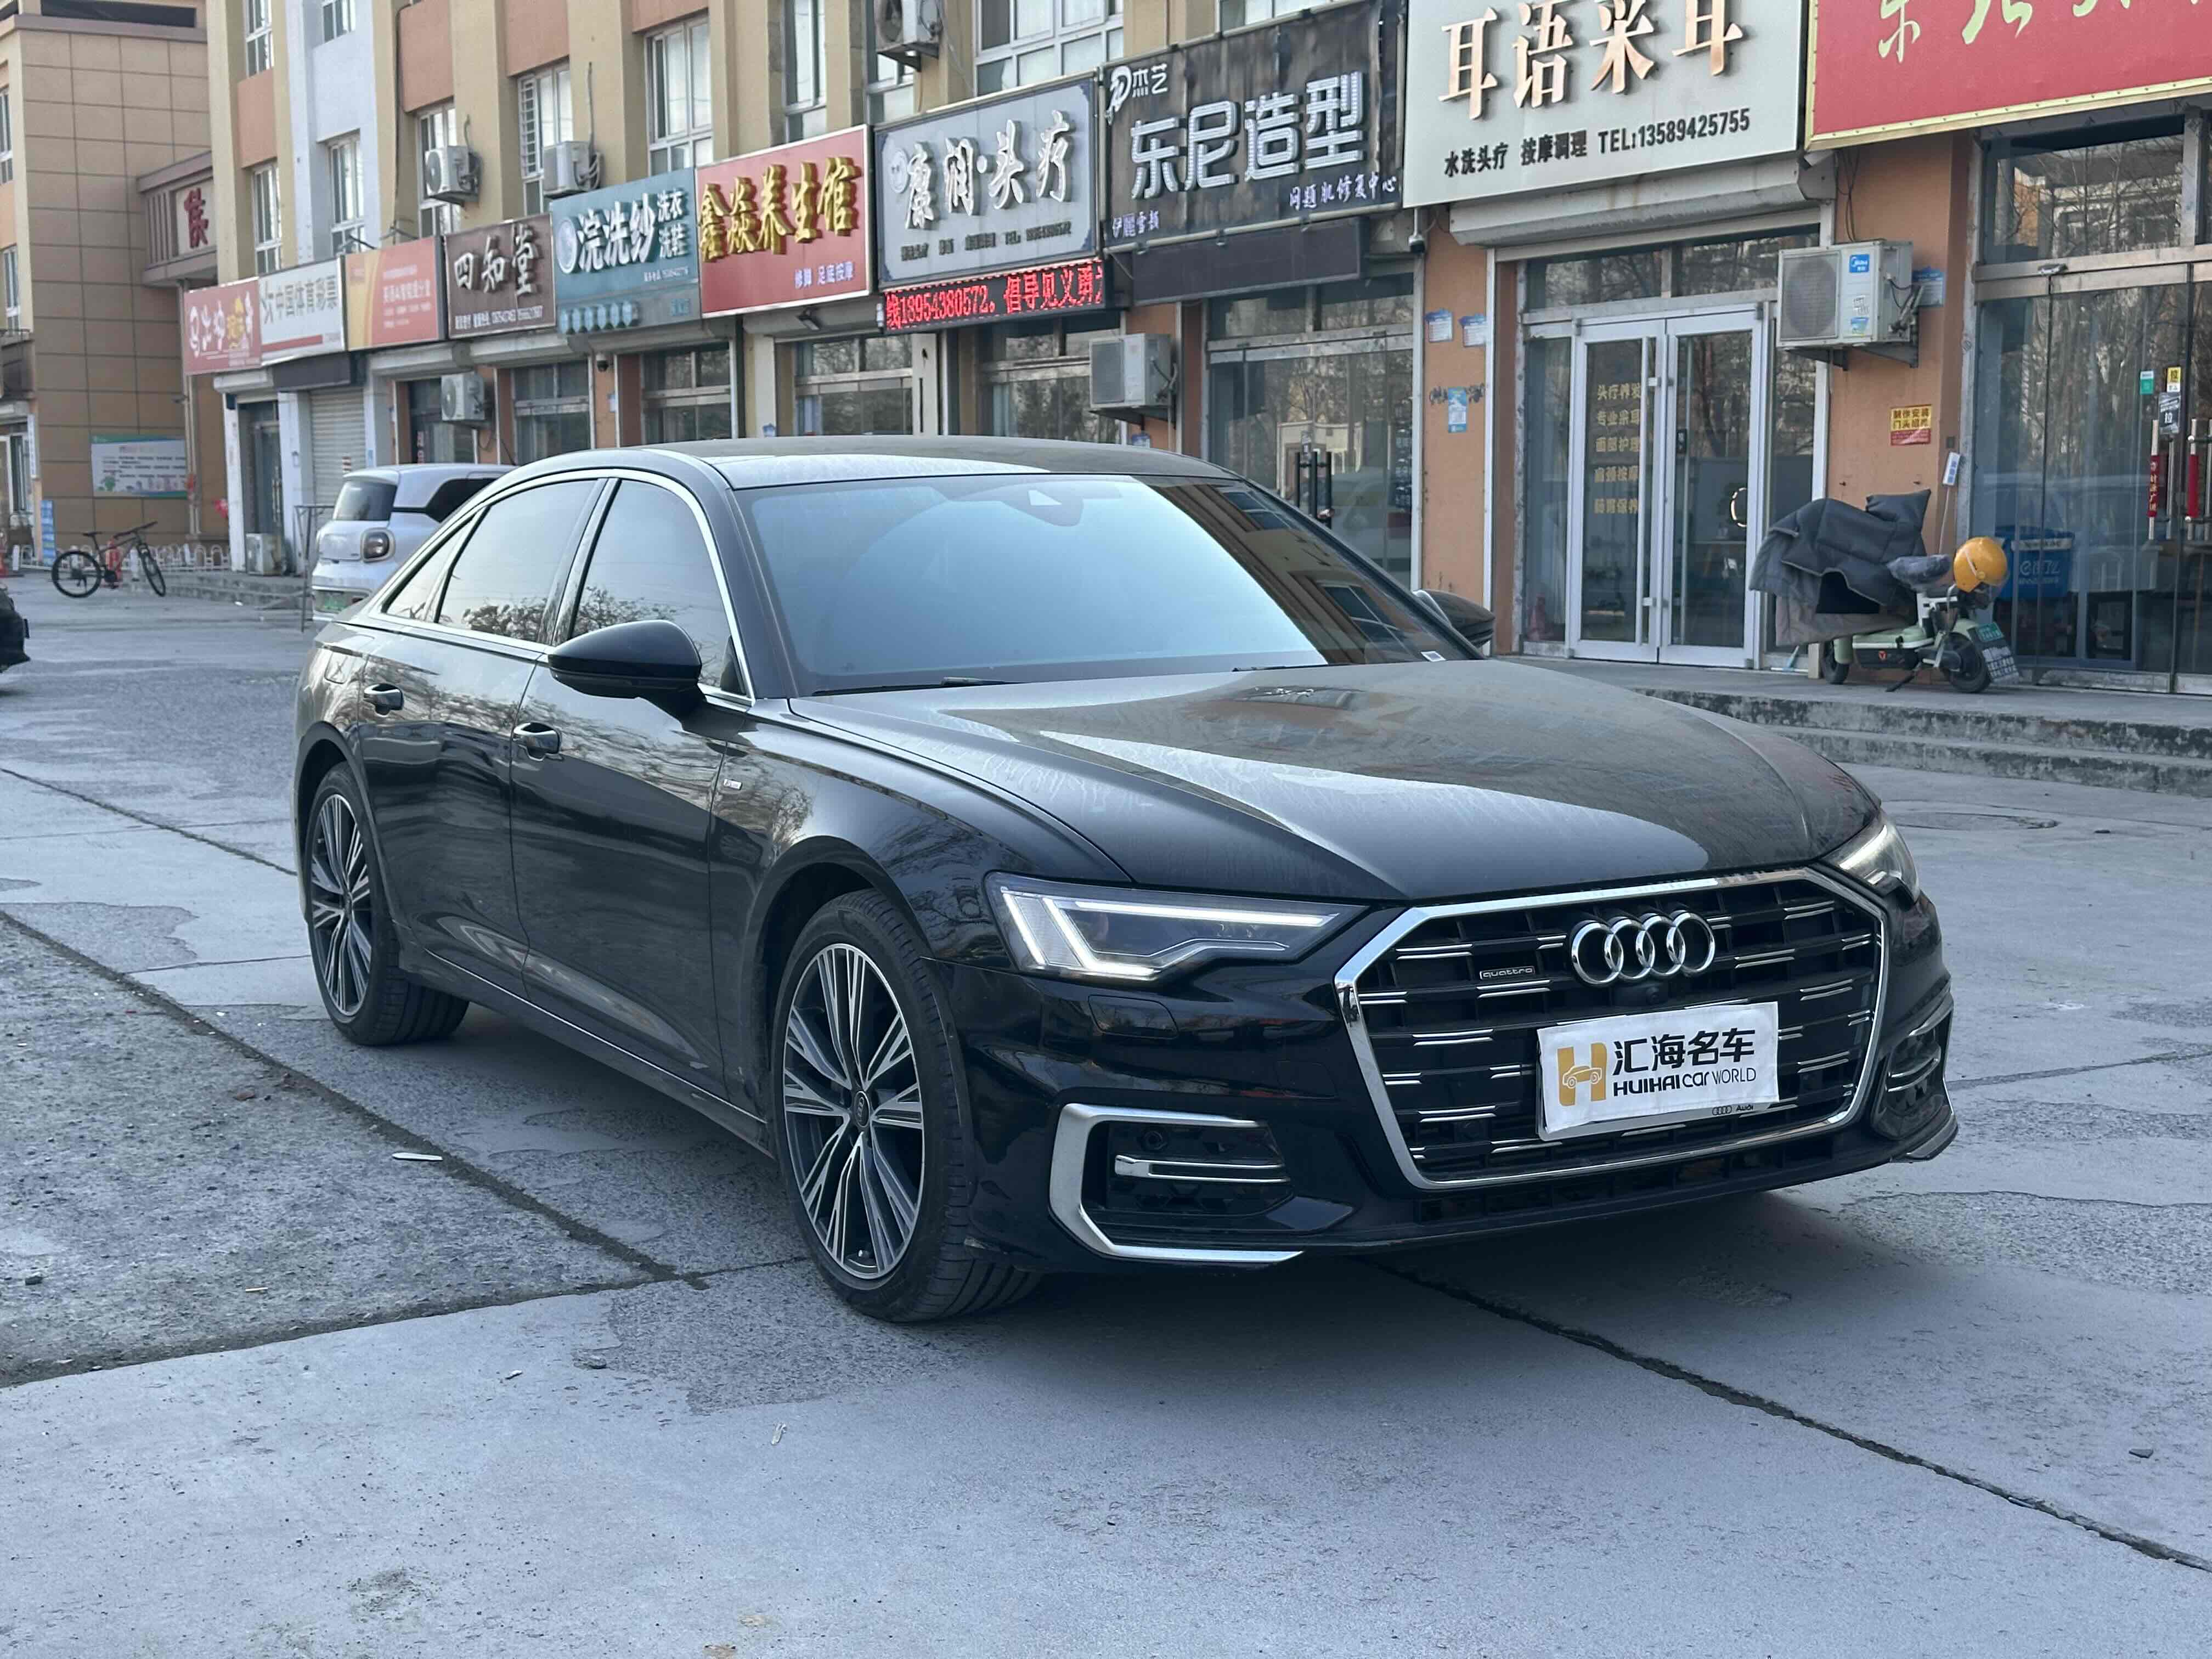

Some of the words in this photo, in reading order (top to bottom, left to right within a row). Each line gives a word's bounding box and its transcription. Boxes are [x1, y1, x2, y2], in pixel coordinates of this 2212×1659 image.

[1130, 70, 1364, 199] 东尼造型
[1444, 142, 1509, 177] 水洗头疗
[1521, 130, 1588, 165] 按摩调理
[1598, 108, 1751, 154] TEL:13589425755
[1289, 171, 1397, 211] 问题肌修复中心
[1483, 967, 1533, 978] quattro
[1612, 1028, 1756, 1076] 汇海名车
[1613, 1076, 1680, 1097] HUIHAI
[1711, 1067, 1757, 1085] WORLD
